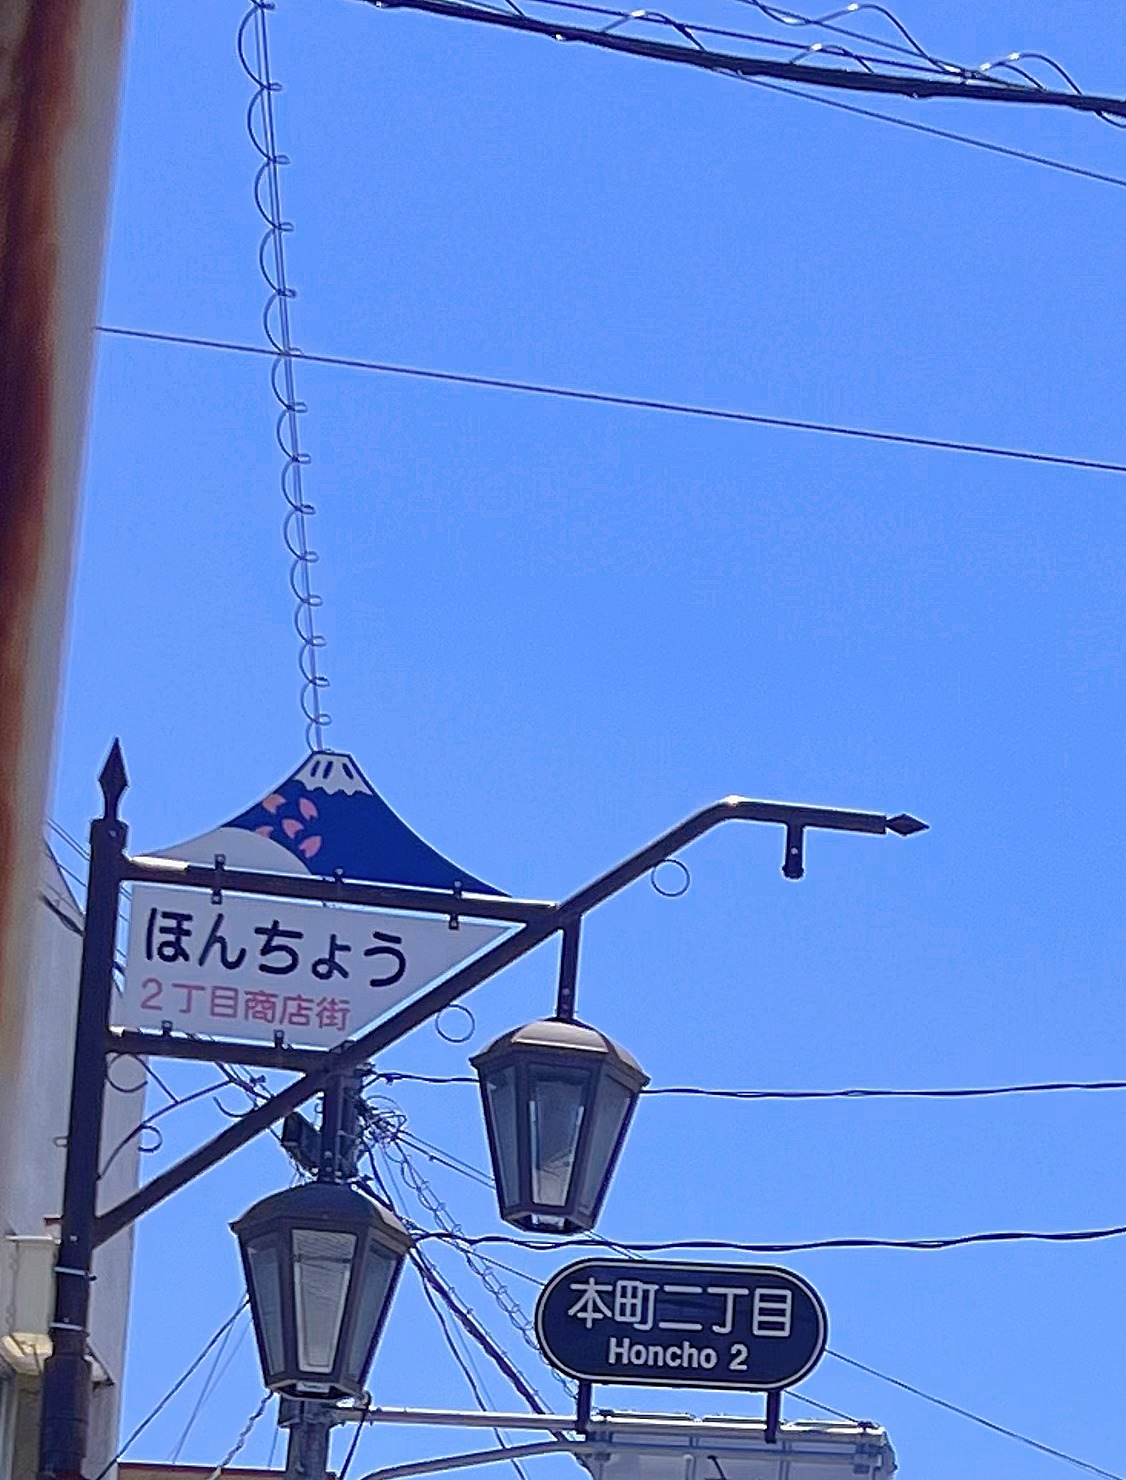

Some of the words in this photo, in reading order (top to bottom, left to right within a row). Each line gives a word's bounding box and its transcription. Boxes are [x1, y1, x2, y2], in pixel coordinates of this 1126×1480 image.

[146, 907, 407, 988] ほんちょう
[140, 977, 350, 1033] 2丁目商店街
[568, 1277, 793, 1337] 本町二丁目
[608, 1337, 718, 1370] Honcho
[728, 1343, 748, 1371] 2
